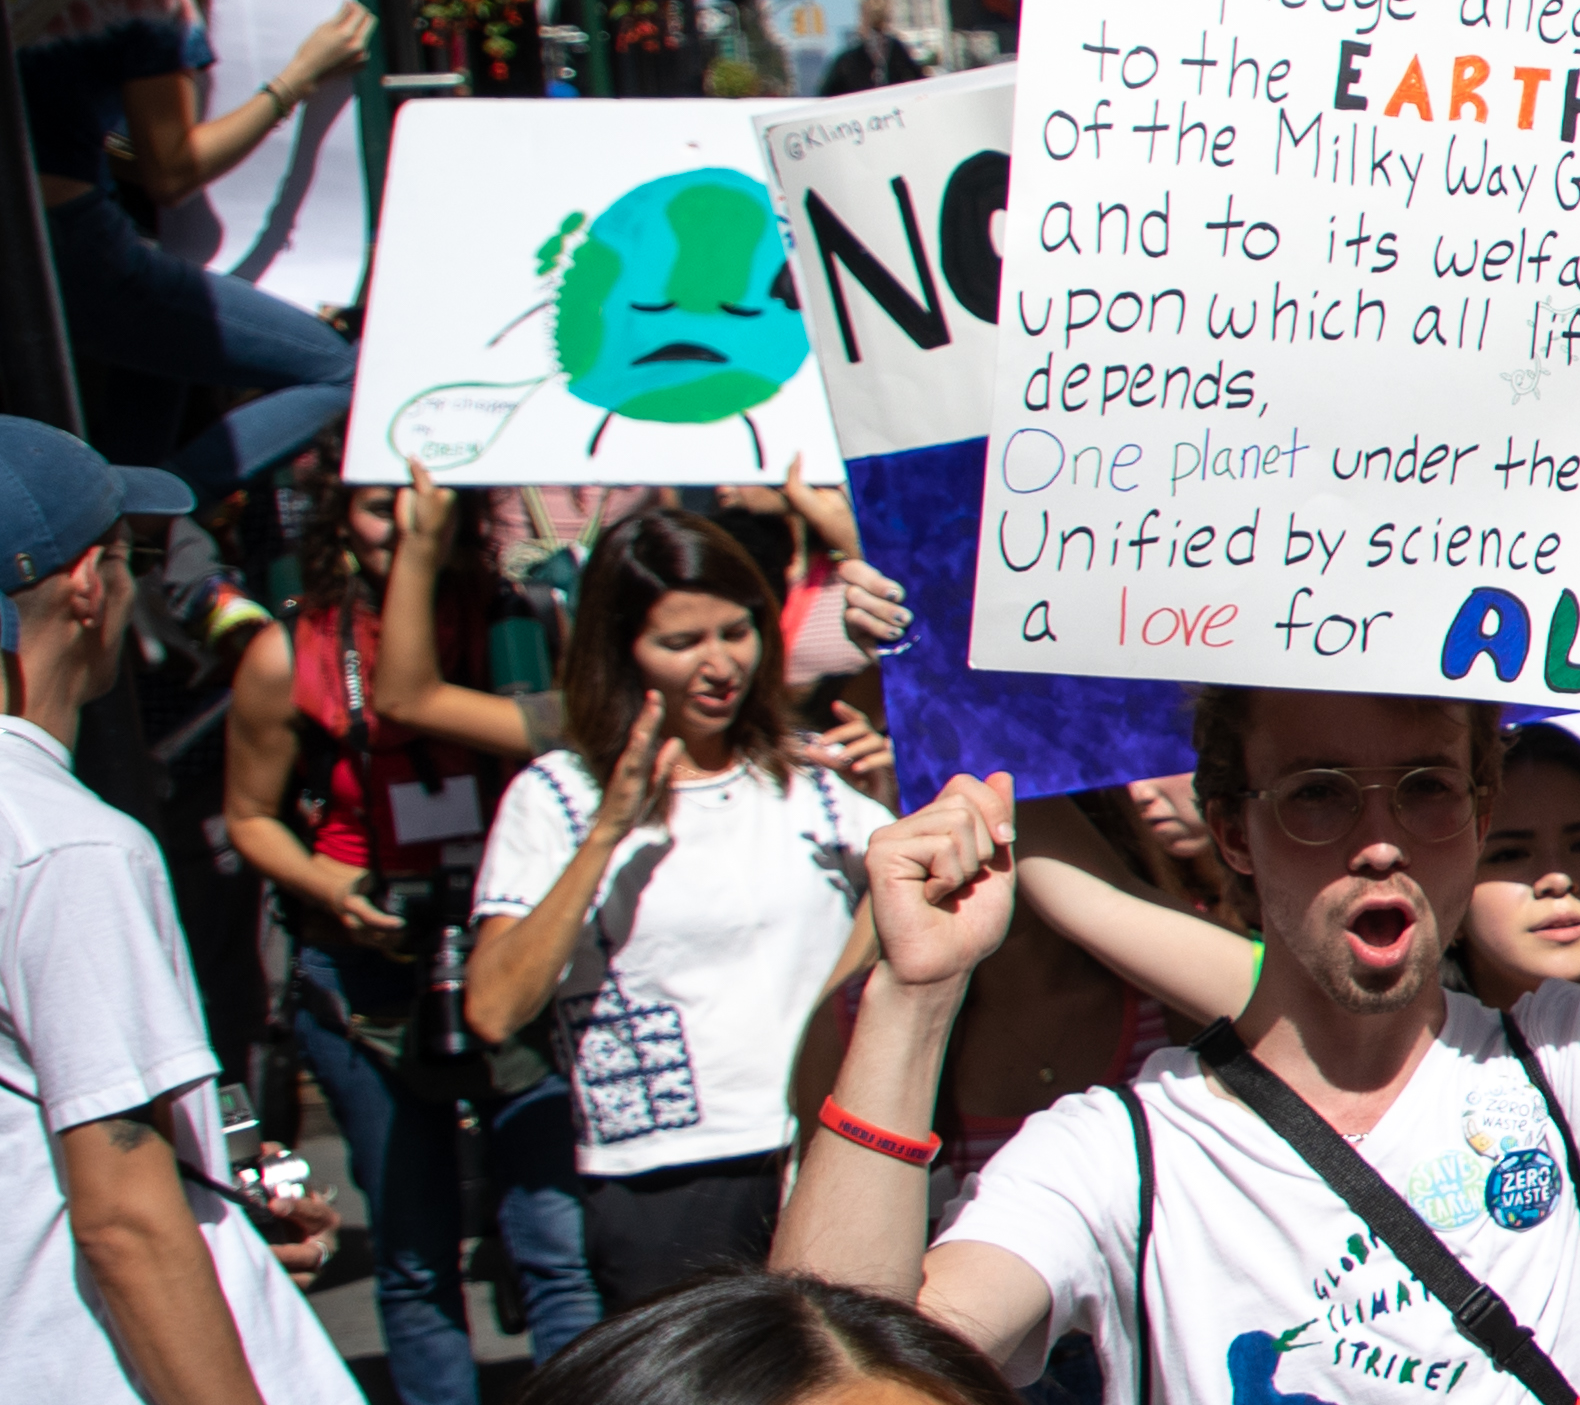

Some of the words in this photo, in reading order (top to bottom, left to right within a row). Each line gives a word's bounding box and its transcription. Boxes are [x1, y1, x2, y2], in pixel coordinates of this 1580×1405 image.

[1082, 20, 1160, 89] to
[1181, 30, 1291, 103] the
[1133, 101, 1237, 167] the
[1275, 110, 1423, 210] Milky
[1444, 136, 1537, 222] Way
[1040, 192, 1172, 260] and
[1205, 200, 1281, 260] to
[1328, 215, 1400, 274] its
[1018, 286, 1186, 338] upon
[1208, 286, 1386, 343] which
[1412, 300, 1490, 349] all
[1024, 354, 1270, 417] depends,
[1003, 428, 1143, 494] One
[1172, 428, 1310, 497] planet
[1333, 437, 1479, 486] under
[999, 507, 1260, 573] Unified
[1284, 511, 1340, 574] by
[1367, 516, 1561, 575] science
[1022, 600, 1057, 645] a
[1119, 586, 1240, 649] love
[1275, 586, 1393, 655] for
[1502, 1166, 1550, 1192] ZERO
[1502, 1186, 1550, 1207] WASTE
[1333, 1337, 1468, 1394] STRIKE!
